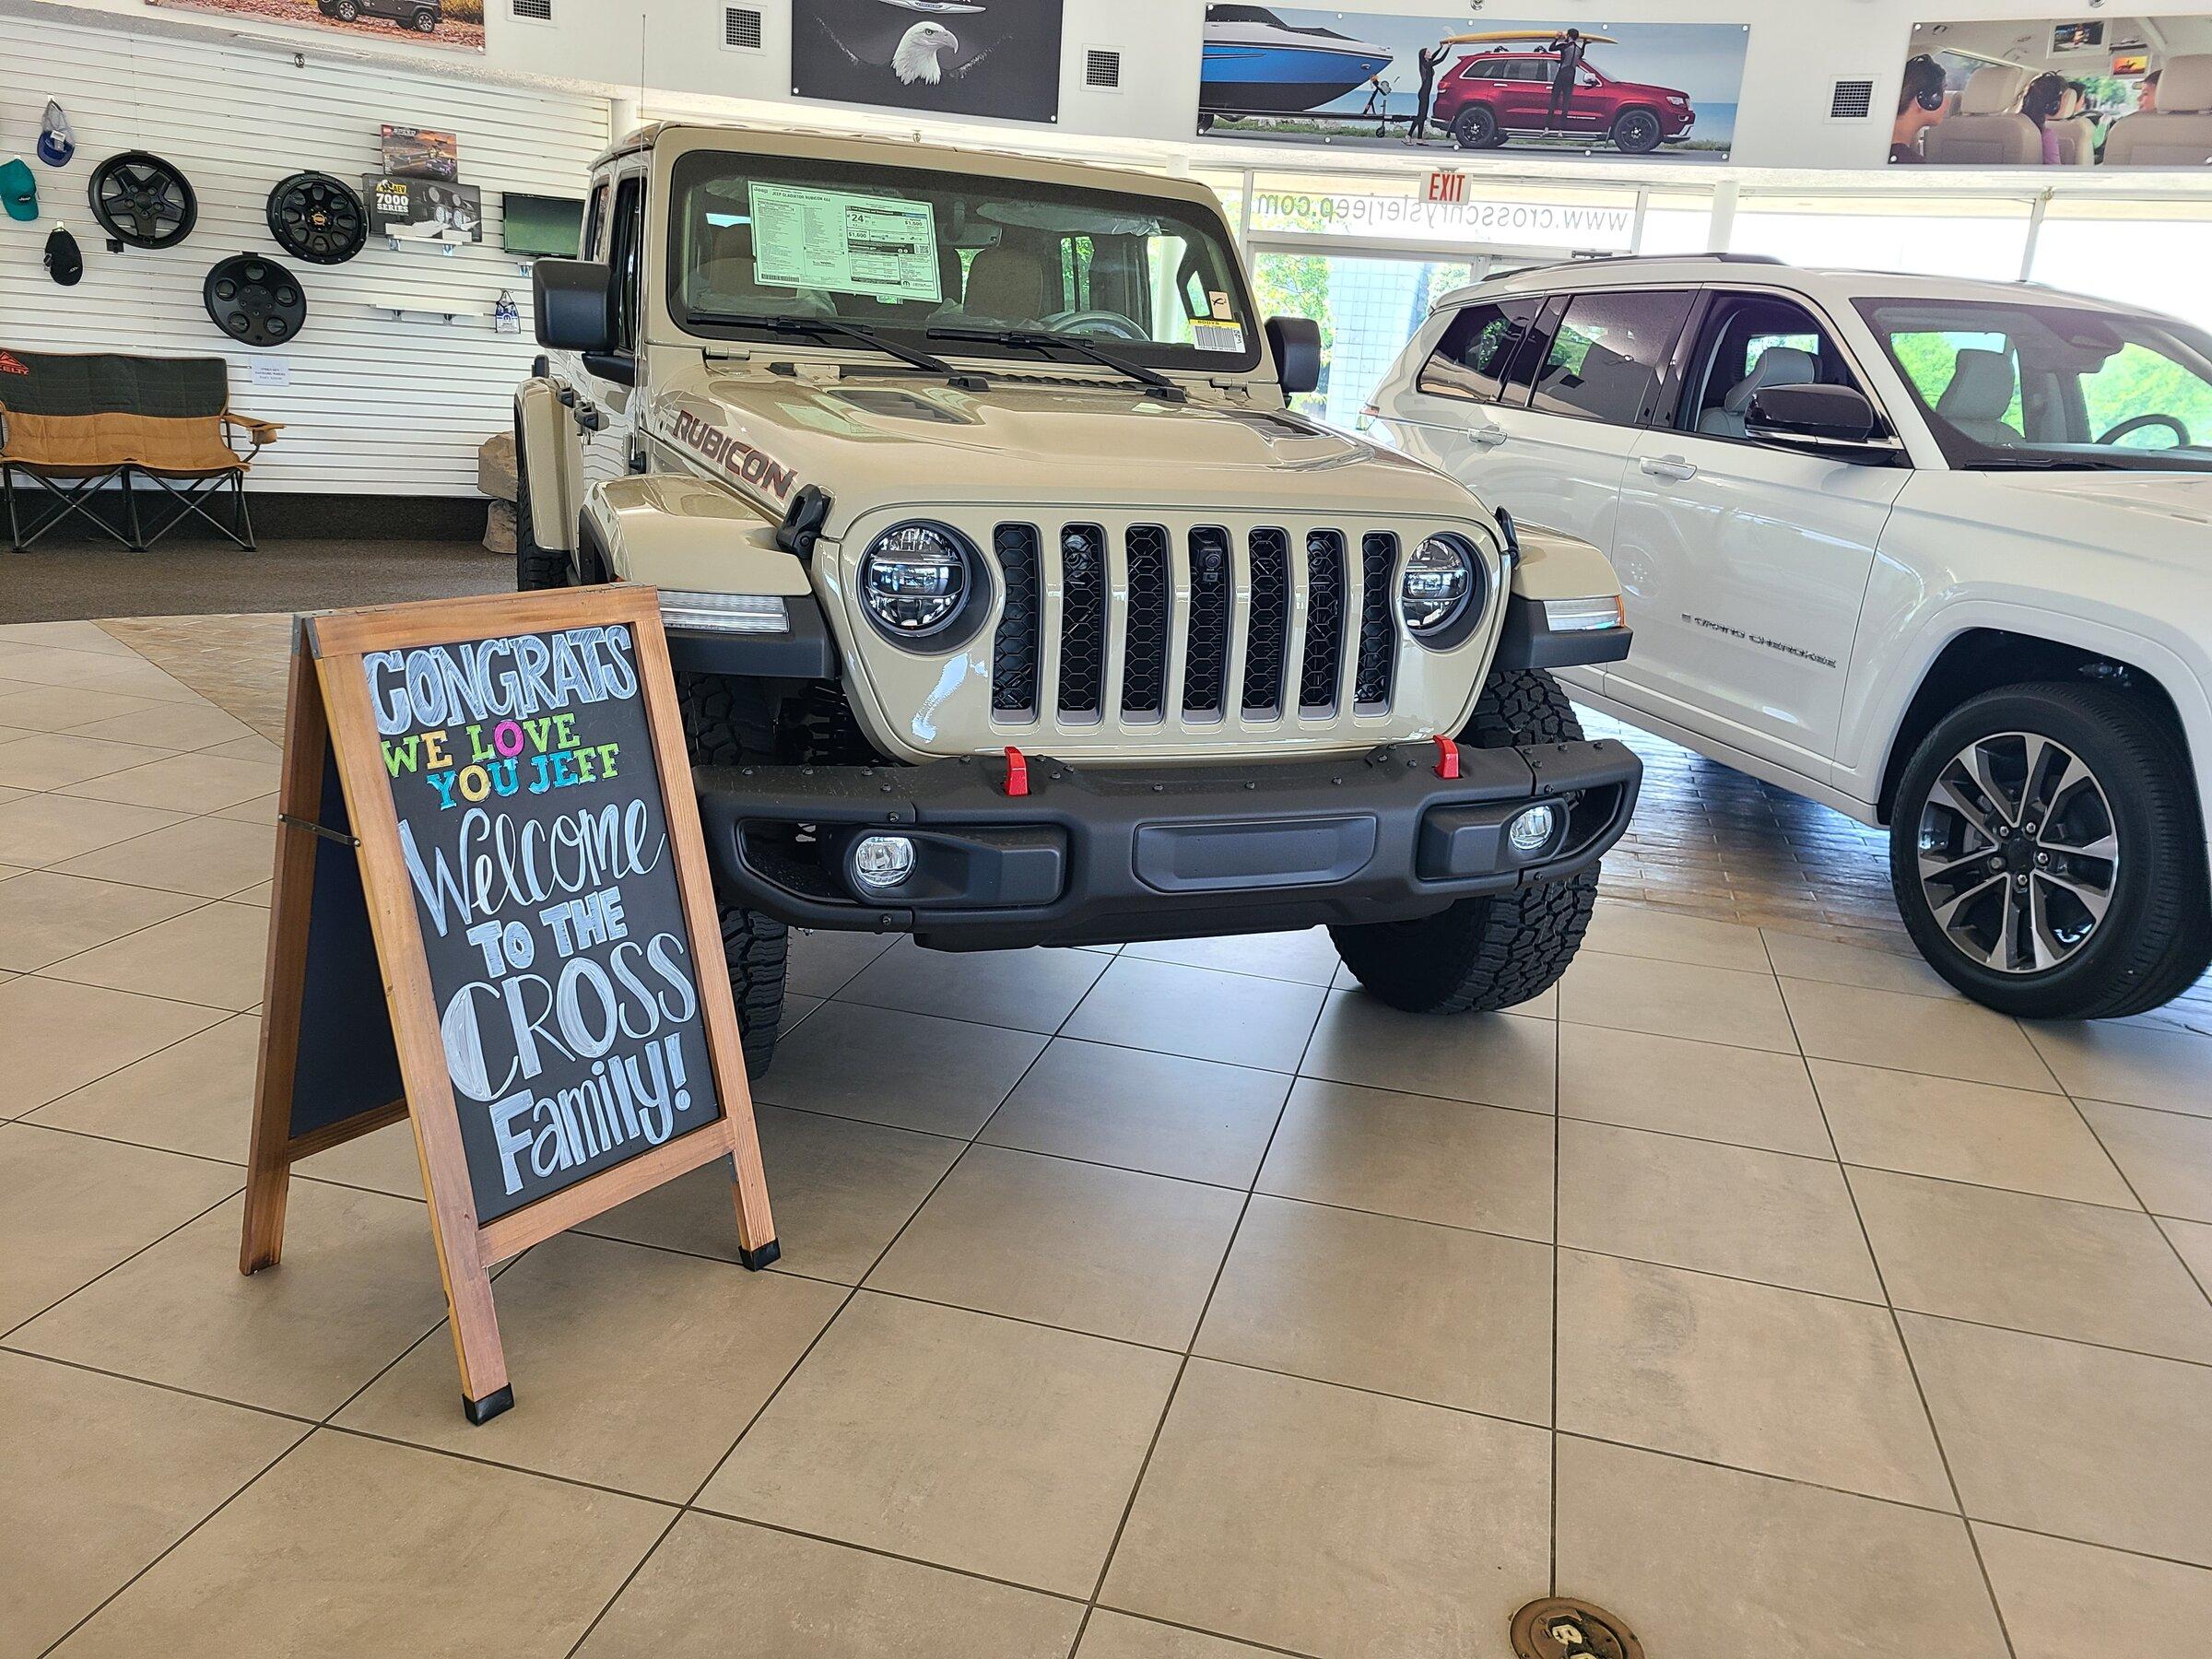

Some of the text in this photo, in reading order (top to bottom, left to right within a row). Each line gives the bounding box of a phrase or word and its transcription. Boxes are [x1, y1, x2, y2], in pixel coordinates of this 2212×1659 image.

[376, 193, 409, 206] 7000
[377, 203, 409, 213] SERIES
[393, 185, 406, 194] AEV
[851, 214, 865, 223] 24
[1429, 173, 1465, 202] EXIT
[673, 409, 798, 500] RUBICON
[363, 624, 638, 735] CONGRATS
[382, 712, 582, 779] WE LOVE
[427, 742, 621, 810] YOU JEFF
[396, 798, 666, 937] Welcome
[467, 885, 629, 979] TO THE
[441, 932, 697, 1101] CROSS
[488, 1032, 692, 1196] Family!
